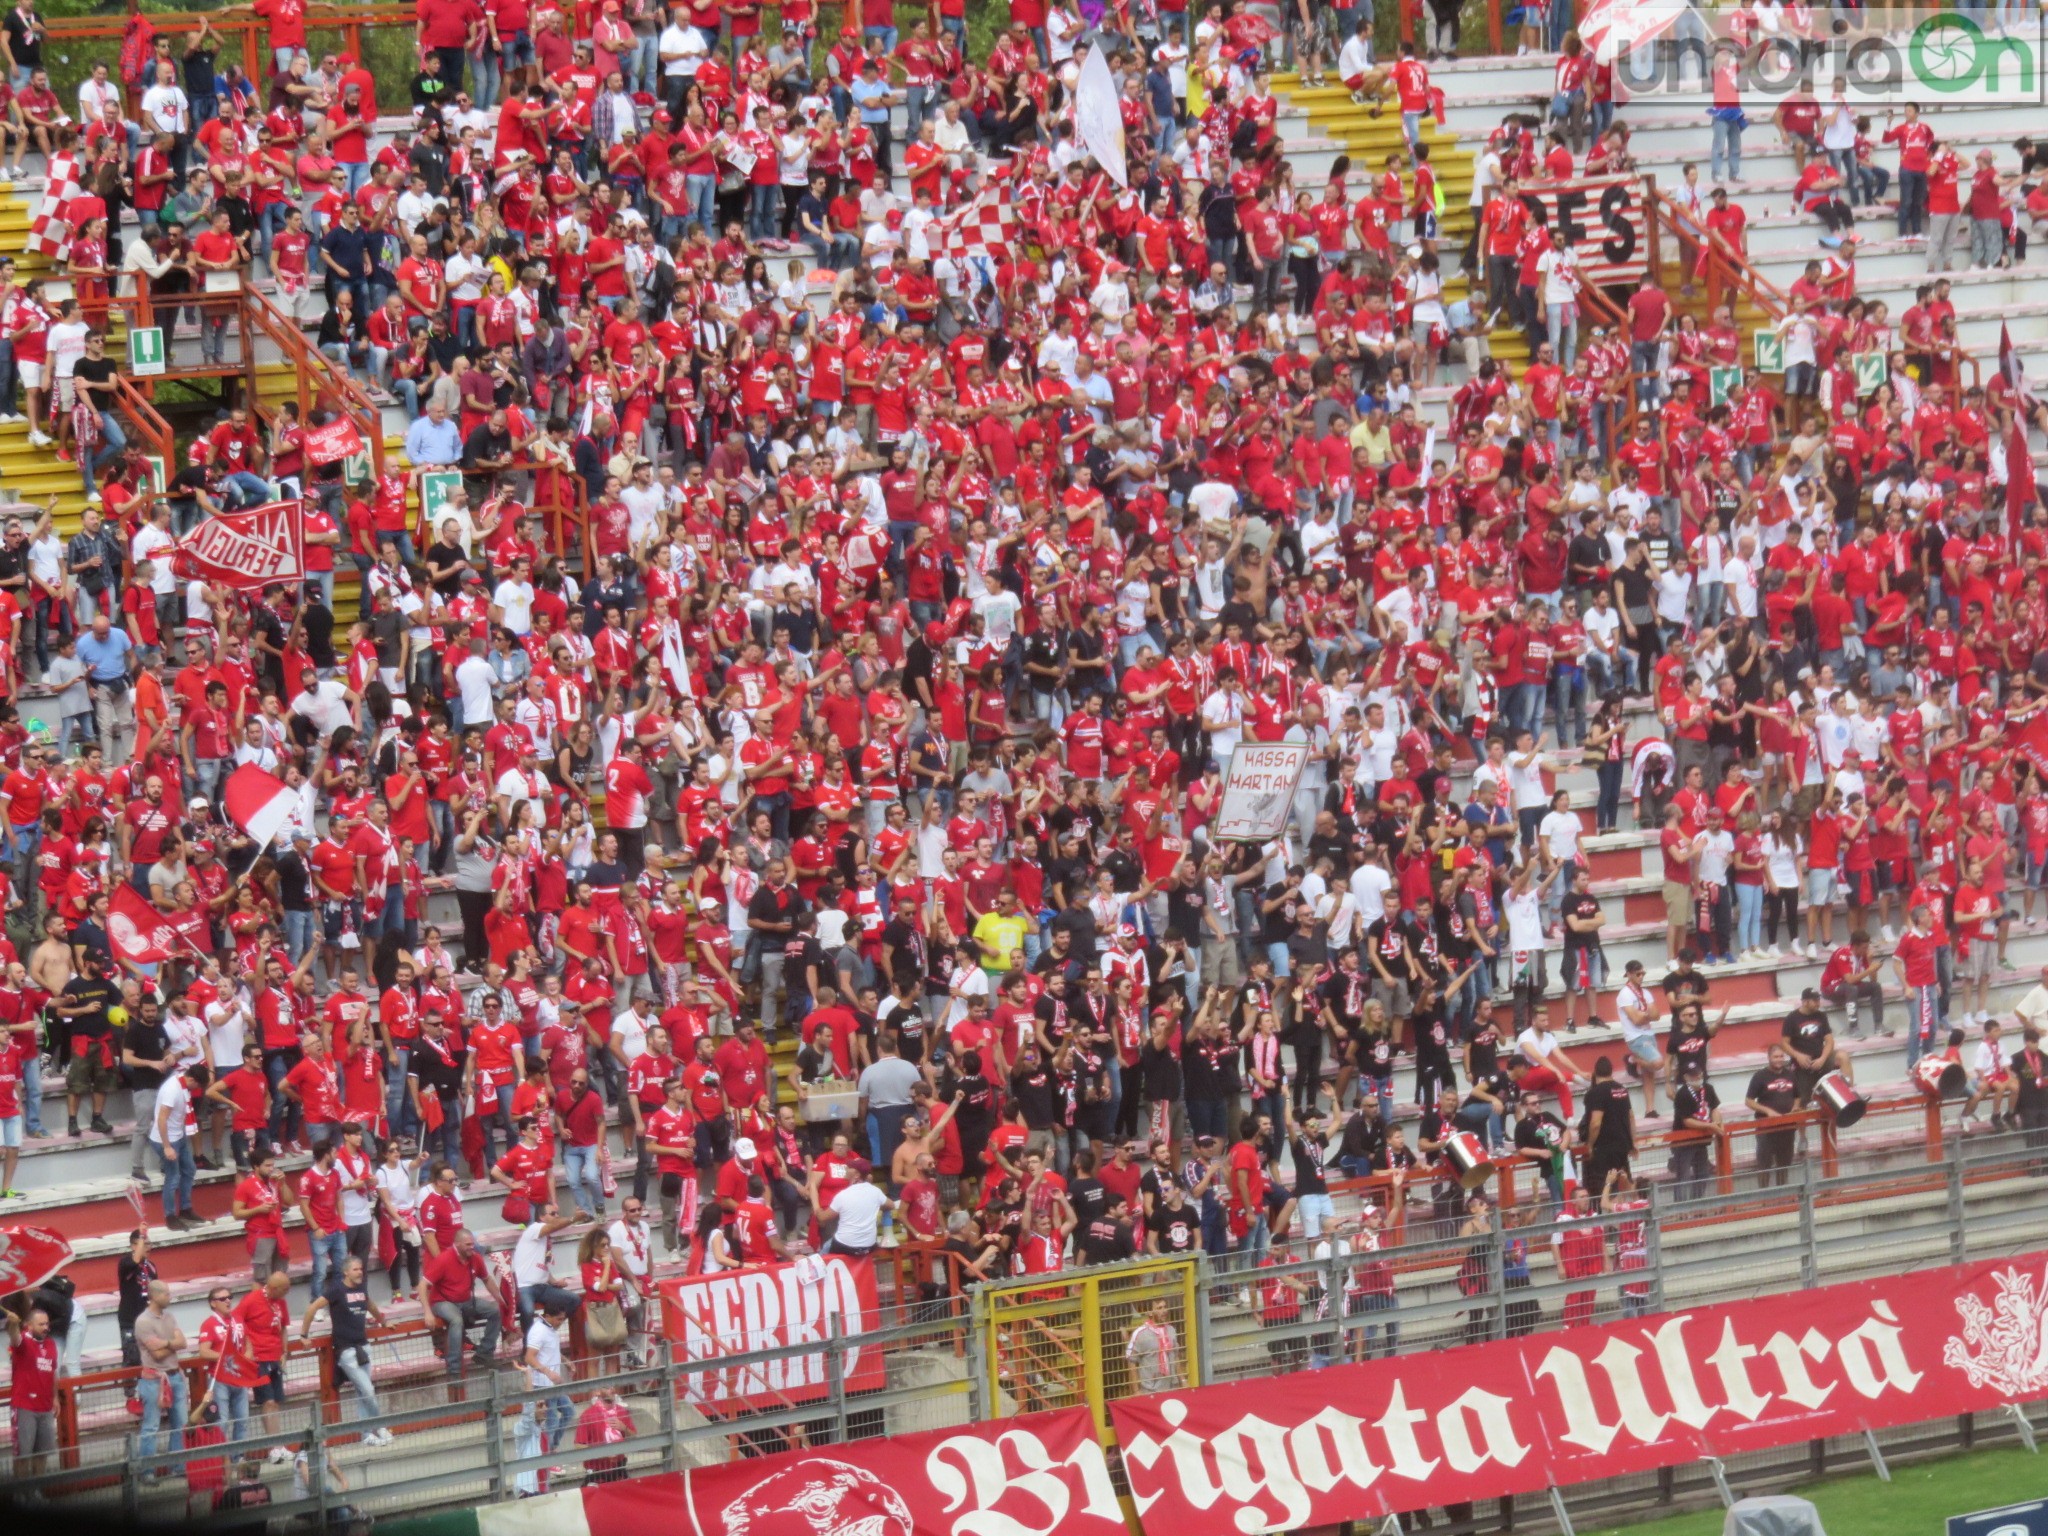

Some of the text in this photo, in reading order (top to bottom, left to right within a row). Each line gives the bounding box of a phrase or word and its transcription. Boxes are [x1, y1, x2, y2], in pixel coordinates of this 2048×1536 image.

[608, 768, 619, 792] 2
[736, 1216, 751, 1245] 14
[679, 1258, 862, 1405] FERRO
[926, 1300, 1924, 1536] Brigata Ultrà
